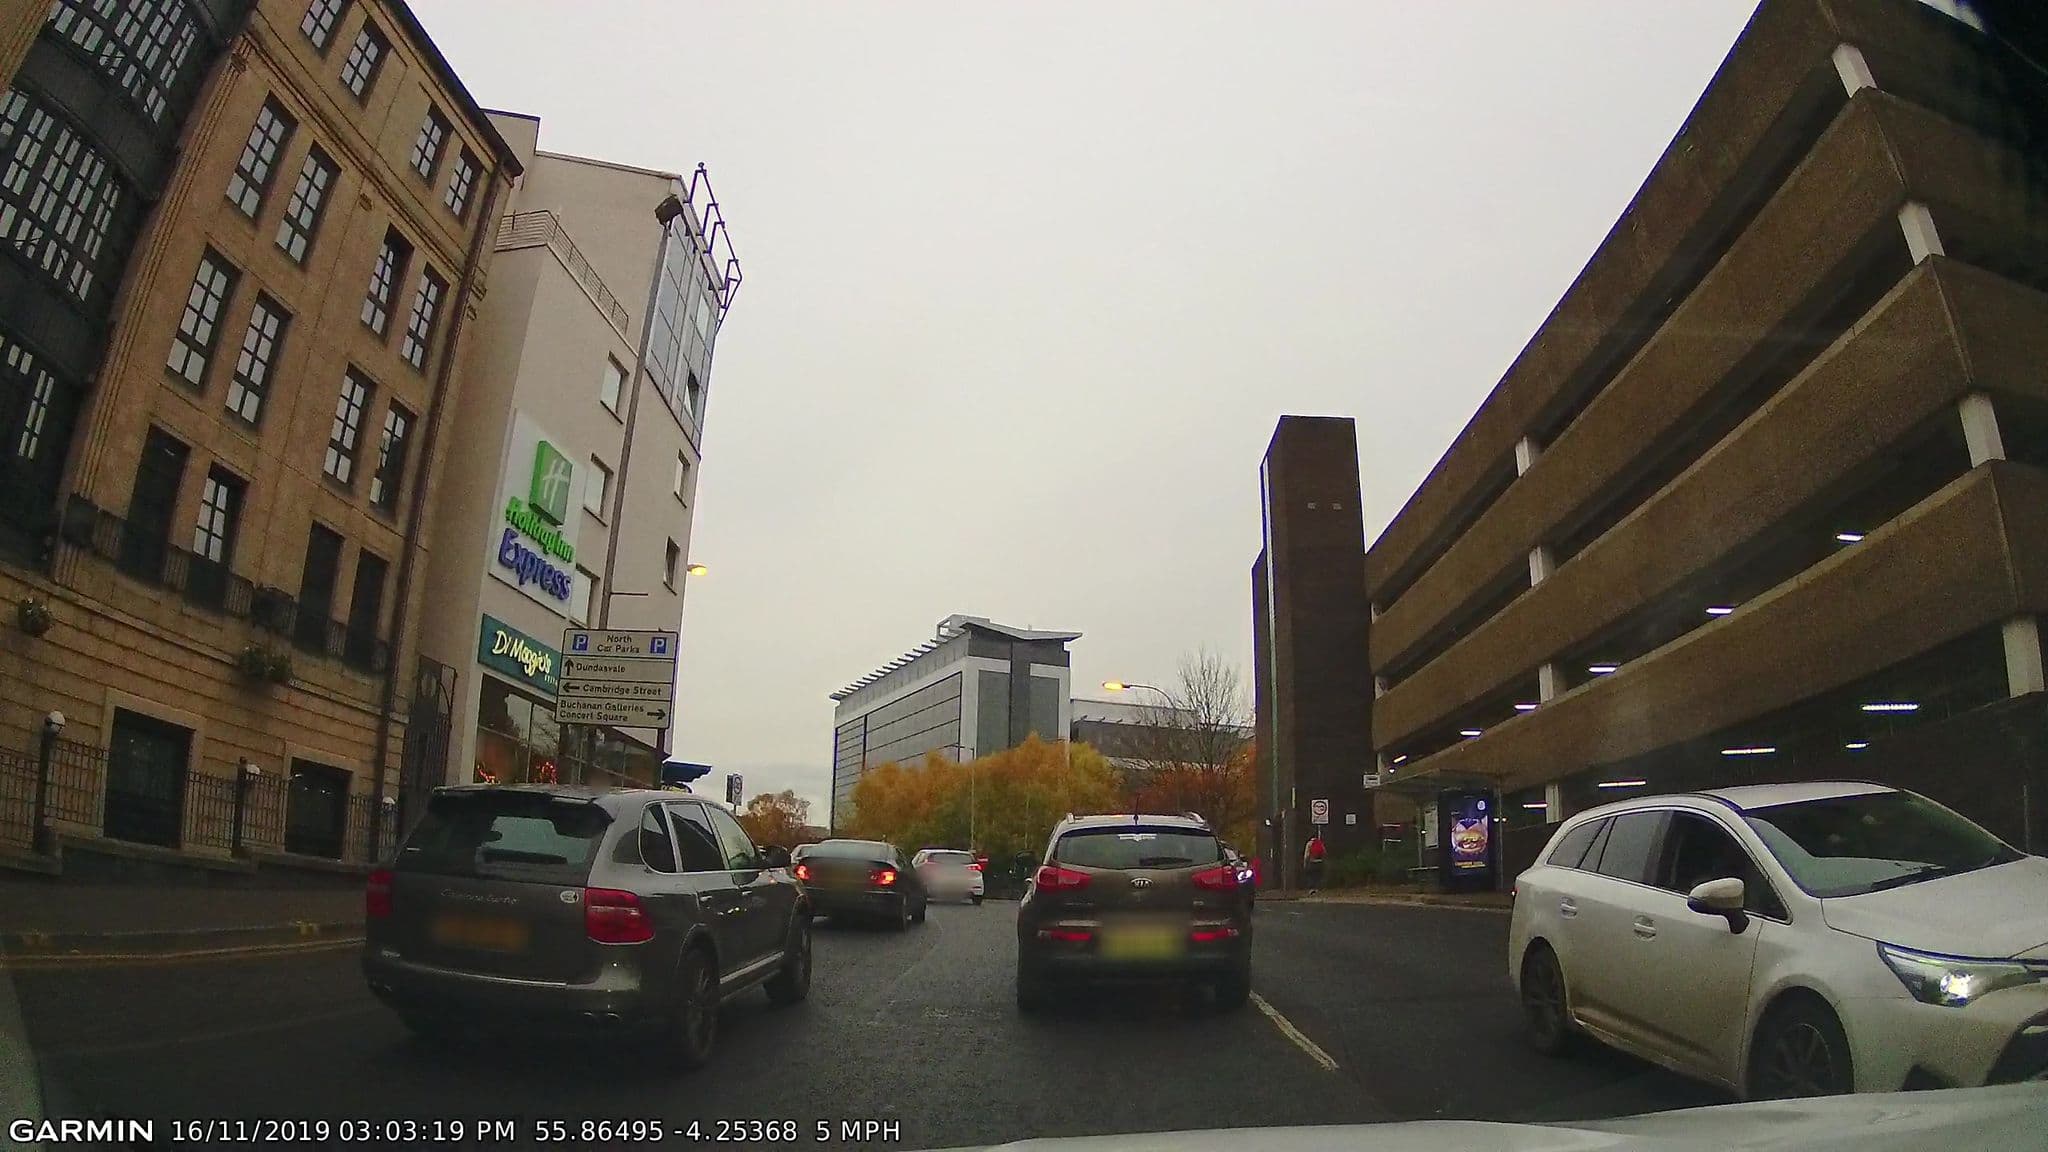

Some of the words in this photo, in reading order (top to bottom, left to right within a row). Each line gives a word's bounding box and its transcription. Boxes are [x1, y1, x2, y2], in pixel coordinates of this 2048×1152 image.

[498, 527, 572, 601] Express
[606, 634, 632, 644] North
[596, 643, 612, 653] Car
[615, 644, 640, 654] Parks
[575, 662, 626, 673] Dundasvale
[582, 684, 631, 696] Cambridge
[632, 686, 662, 696] Street
[560, 700, 602, 710] Buchanan
[604, 702, 645, 713] Galleries
[559, 710, 594, 720] Concert
[596, 711, 629, 722] Square
